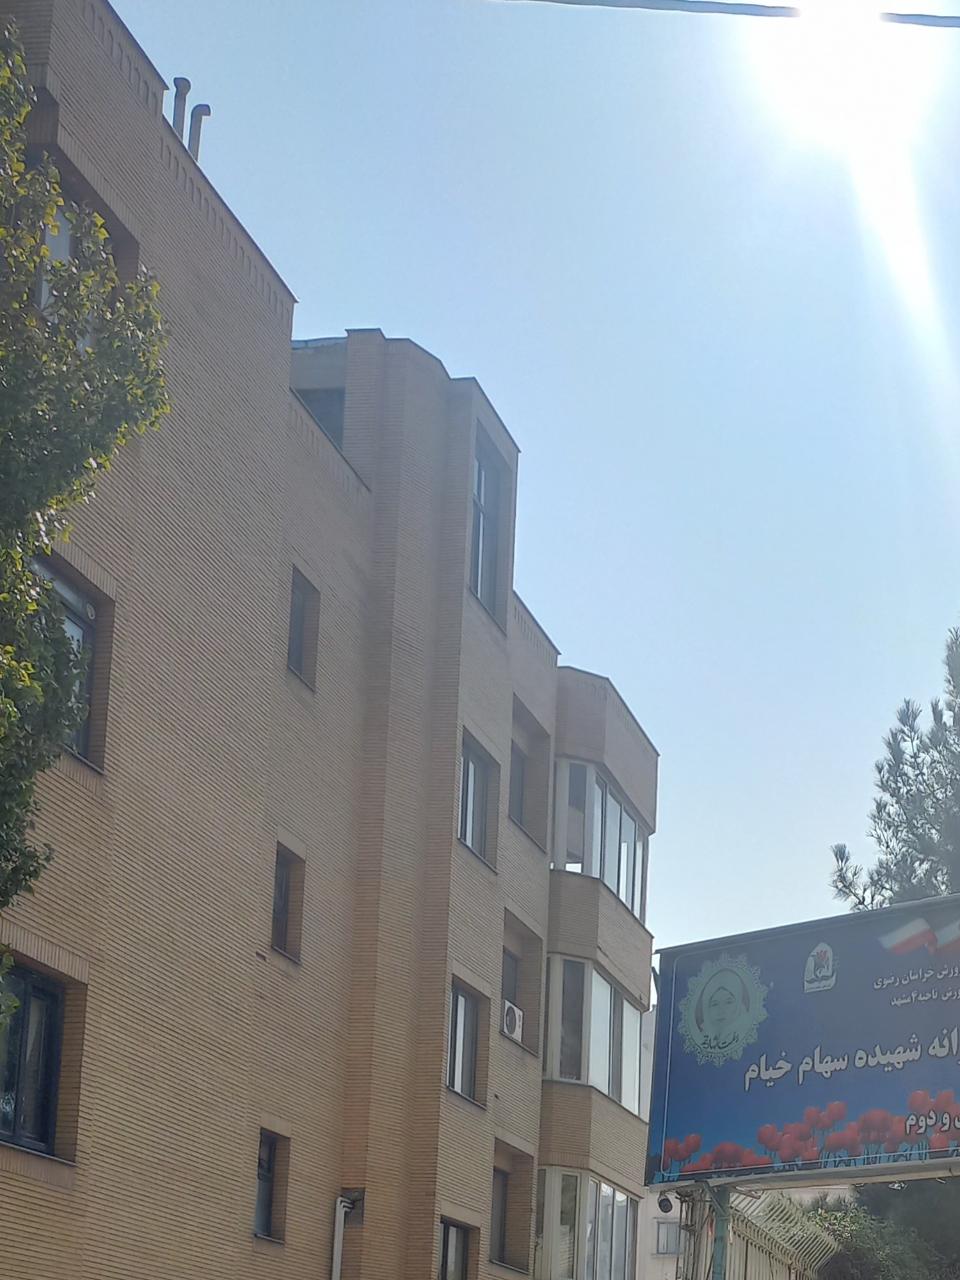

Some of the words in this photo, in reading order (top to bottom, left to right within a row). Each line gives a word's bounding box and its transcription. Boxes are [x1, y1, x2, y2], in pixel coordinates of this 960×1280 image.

[901, 968, 935, 985] خراسان
[798, 1045, 850, 1085] سهام
[854, 1033, 922, 1073] شهیده
[744, 1051, 793, 1092] خیام
[905, 1109, 937, 1135] دوم
[940, 1111, 951, 1132] و
